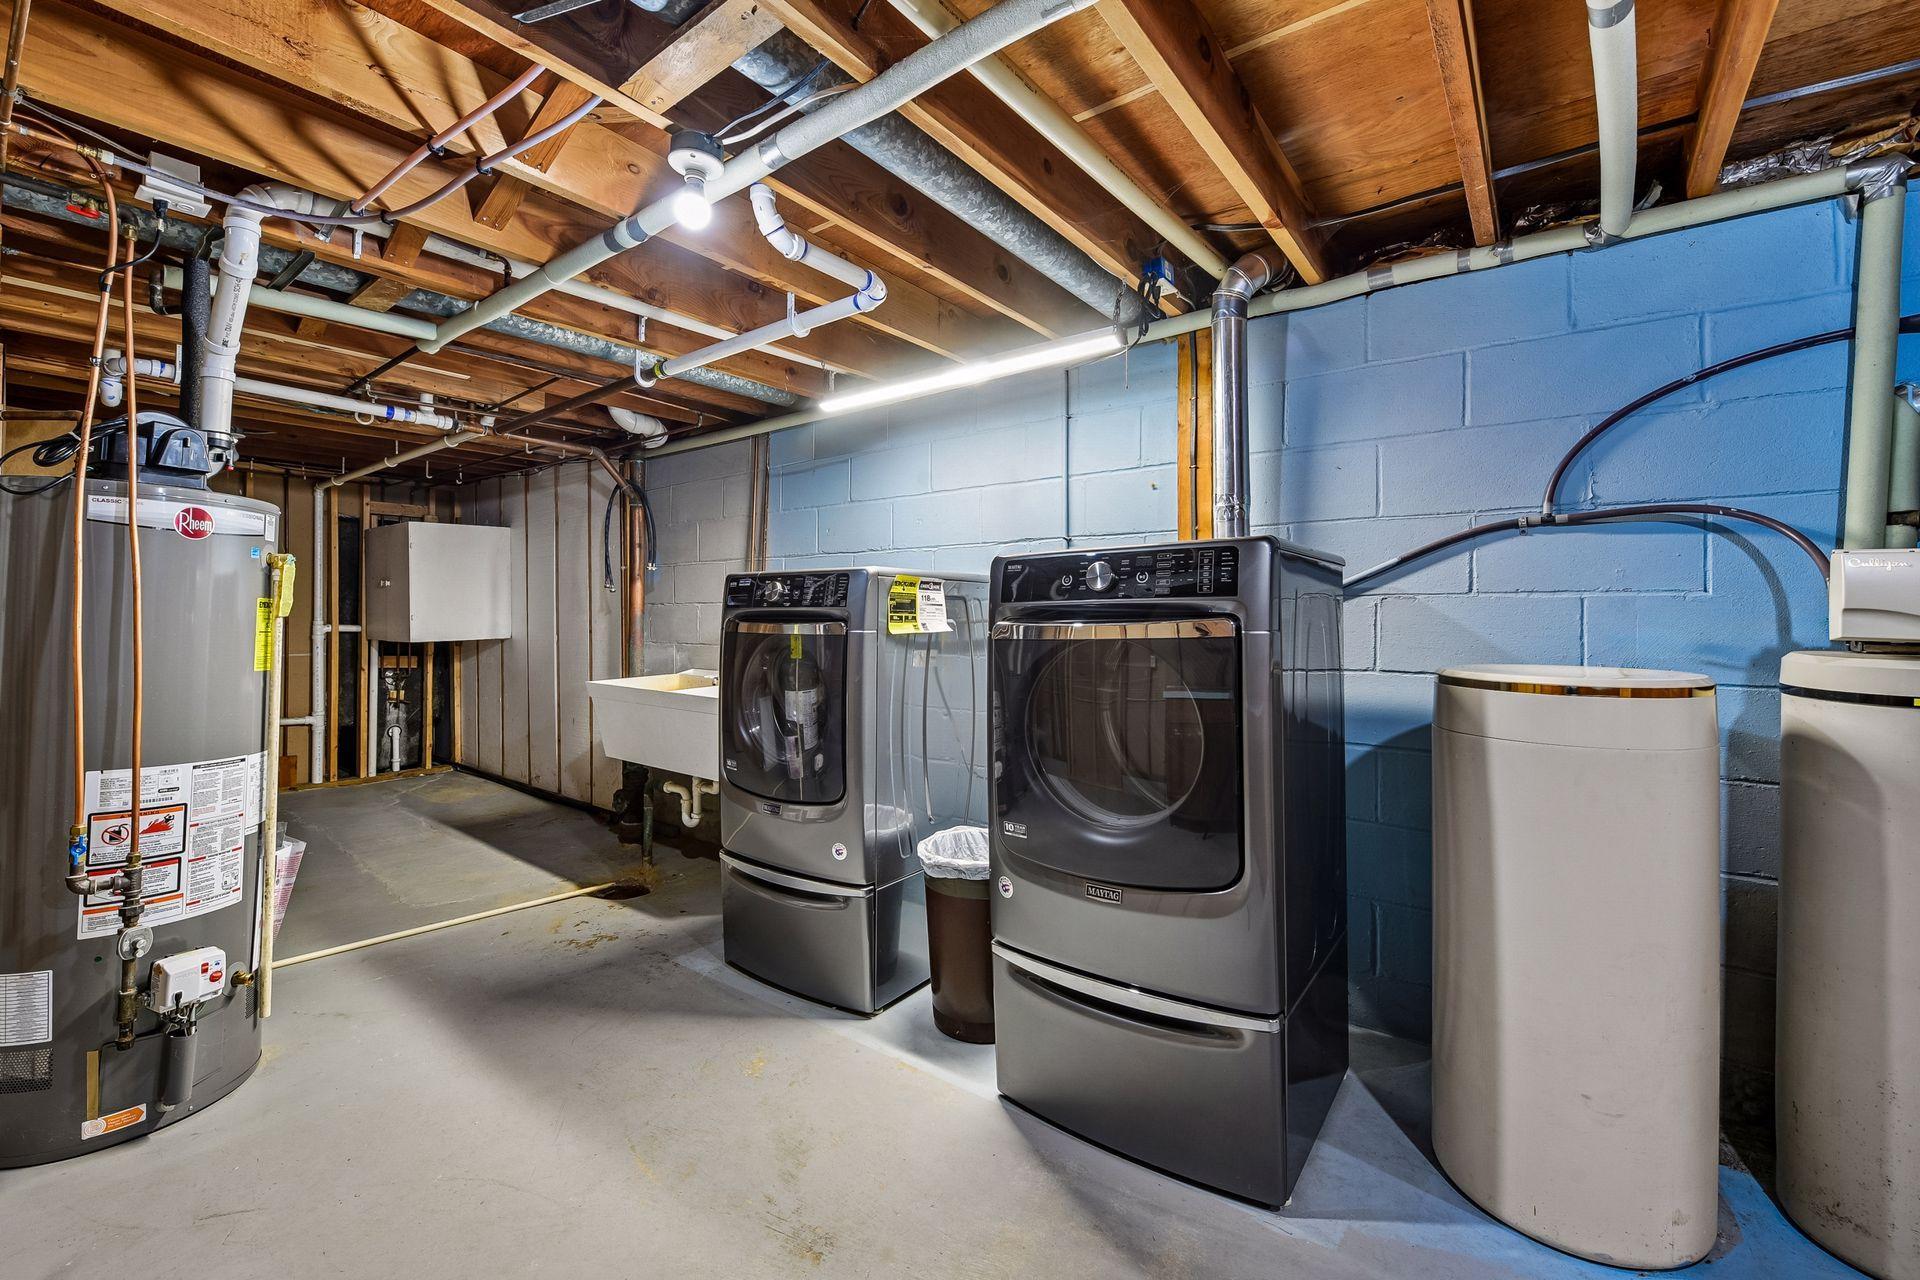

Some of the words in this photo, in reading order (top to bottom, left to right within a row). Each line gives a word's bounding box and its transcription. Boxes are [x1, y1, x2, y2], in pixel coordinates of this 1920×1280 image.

[178, 507, 213, 535] Rheem
[1848, 557, 1909, 571] Culligan
[921, 594, 930, 602] 118
[1005, 822, 1014, 832] 10
[1087, 886, 1119, 901] MAYTAG
